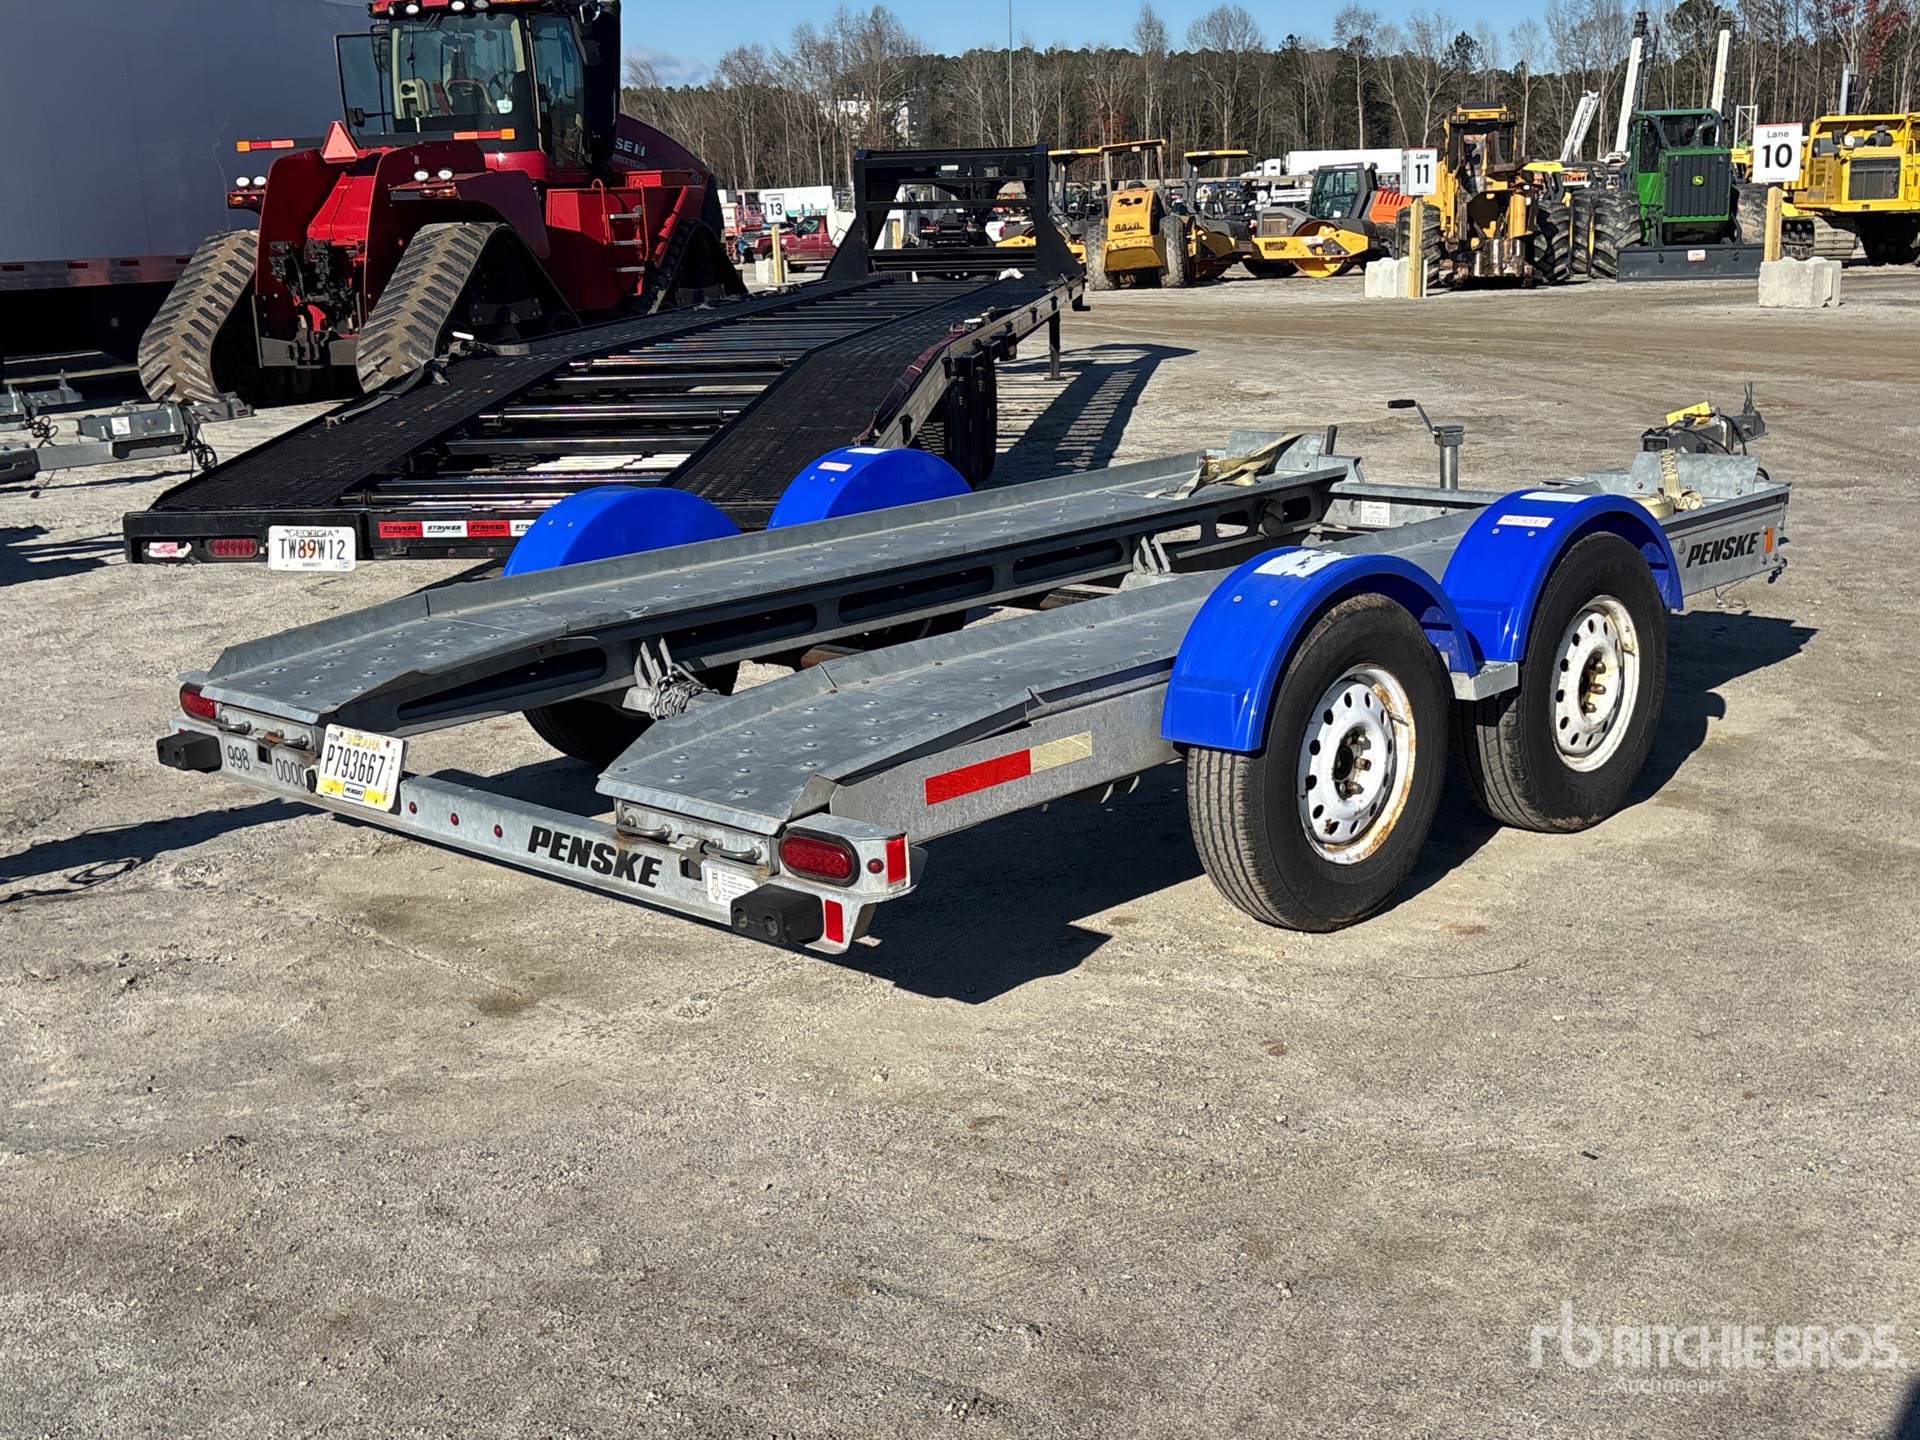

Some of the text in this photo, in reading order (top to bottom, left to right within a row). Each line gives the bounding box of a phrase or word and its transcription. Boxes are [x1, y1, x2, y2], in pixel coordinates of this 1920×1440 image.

[614, 137, 633, 153] SE
[1762, 143, 1793, 168] 10
[1415, 164, 1429, 184] 11
[770, 203, 783, 216] 13
[288, 529, 335, 538] GEORGIA
[427, 525, 462, 533] STRYKER
[470, 524, 506, 532] STRYKER
[278, 538, 346, 560] TW89W12
[1685, 532, 1760, 569] PENSKE
[227, 745, 250, 770] 998
[325, 744, 386, 786] P793667
[275, 758, 305, 786] 0000
[345, 787, 363, 797] PENSKE
[527, 825, 663, 888] PENSKE
